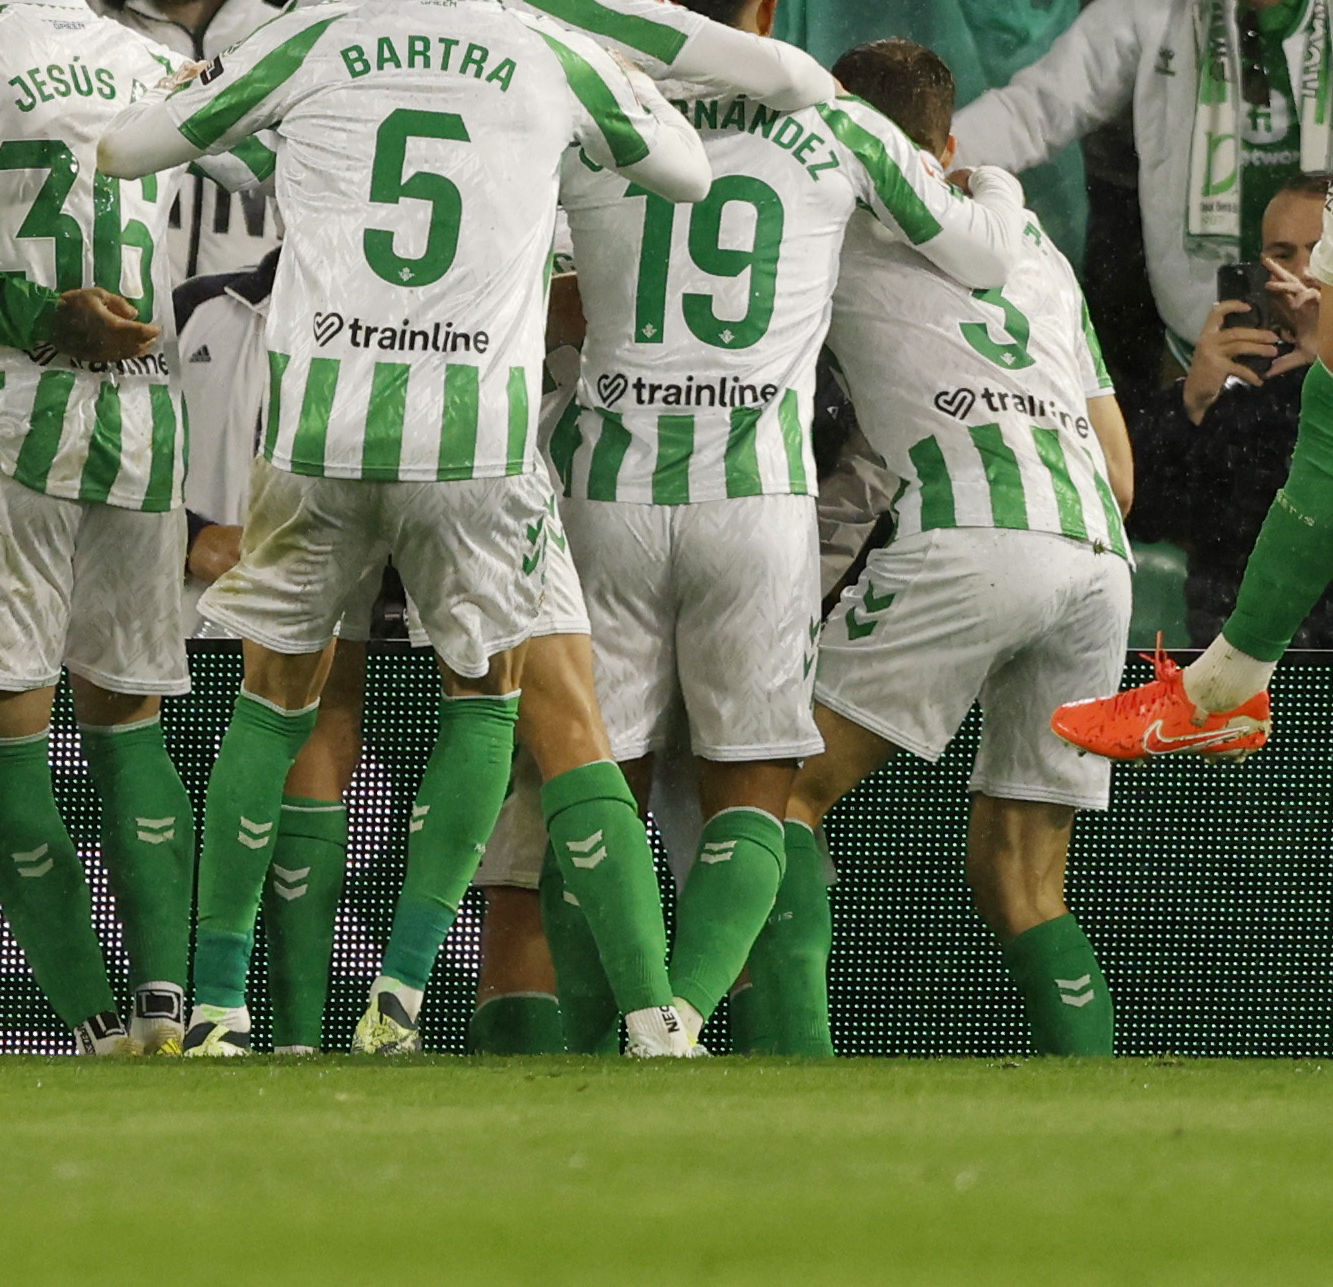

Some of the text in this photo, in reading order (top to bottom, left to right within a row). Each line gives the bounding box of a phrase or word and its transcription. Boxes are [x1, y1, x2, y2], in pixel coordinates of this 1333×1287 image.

[8, 56, 117, 113] JESÚS
[339, 35, 517, 93] BARTRA
[363, 108, 471, 288] 5
[623, 174, 785, 350] 19
[348, 318, 489, 354] trainline
[959, 286, 1037, 370] 3
[632, 375, 779, 408] trainline
